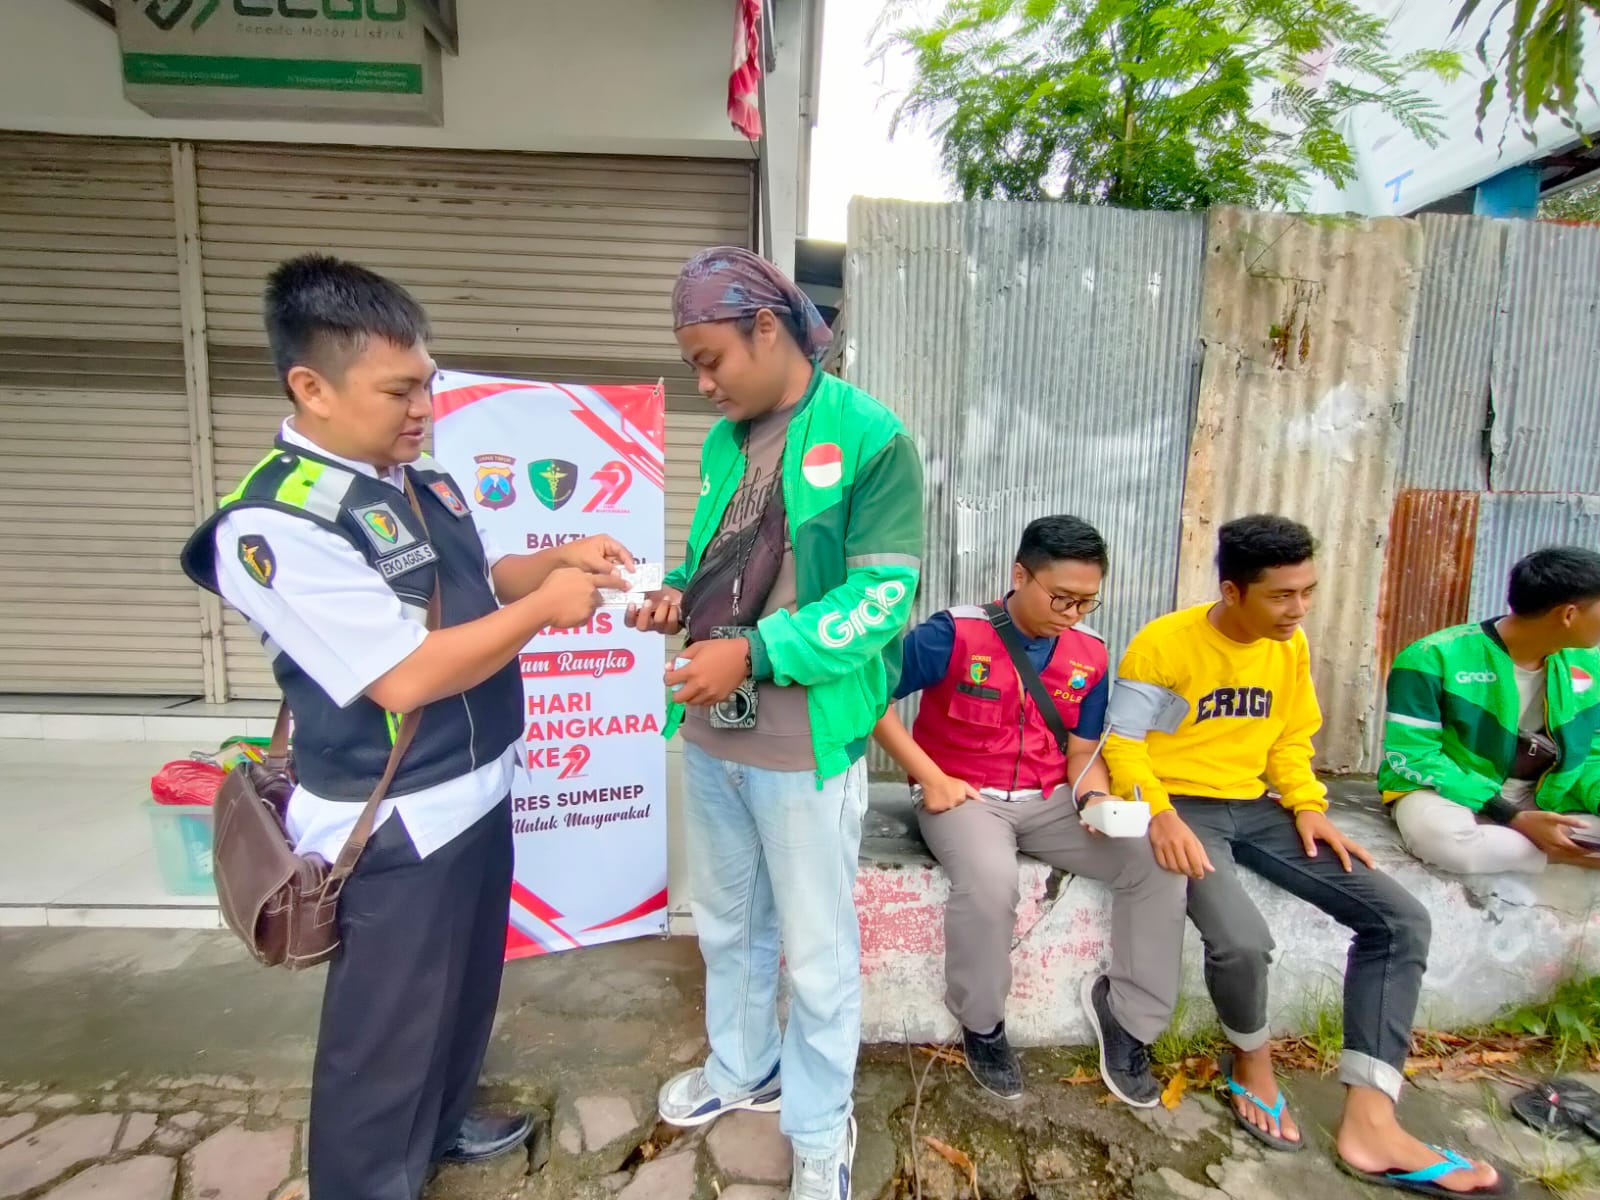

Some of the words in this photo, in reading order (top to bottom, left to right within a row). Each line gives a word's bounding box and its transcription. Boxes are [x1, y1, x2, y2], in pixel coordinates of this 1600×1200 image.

[526, 533, 587, 549] BAKT
[382, 558, 403, 576] EKO
[423, 546, 433, 558] S
[817, 580, 906, 649] Grab
[557, 650, 628, 677] Rangka
[1455, 670, 1498, 685] Grab
[528, 691, 591, 716] HARI
[524, 713, 659, 742] ANGKARA
[527, 747, 560, 769] KE
[511, 794, 551, 813] RES
[556, 784, 644, 808] SUMENEP
[563, 803, 651, 830] Masyarakat
